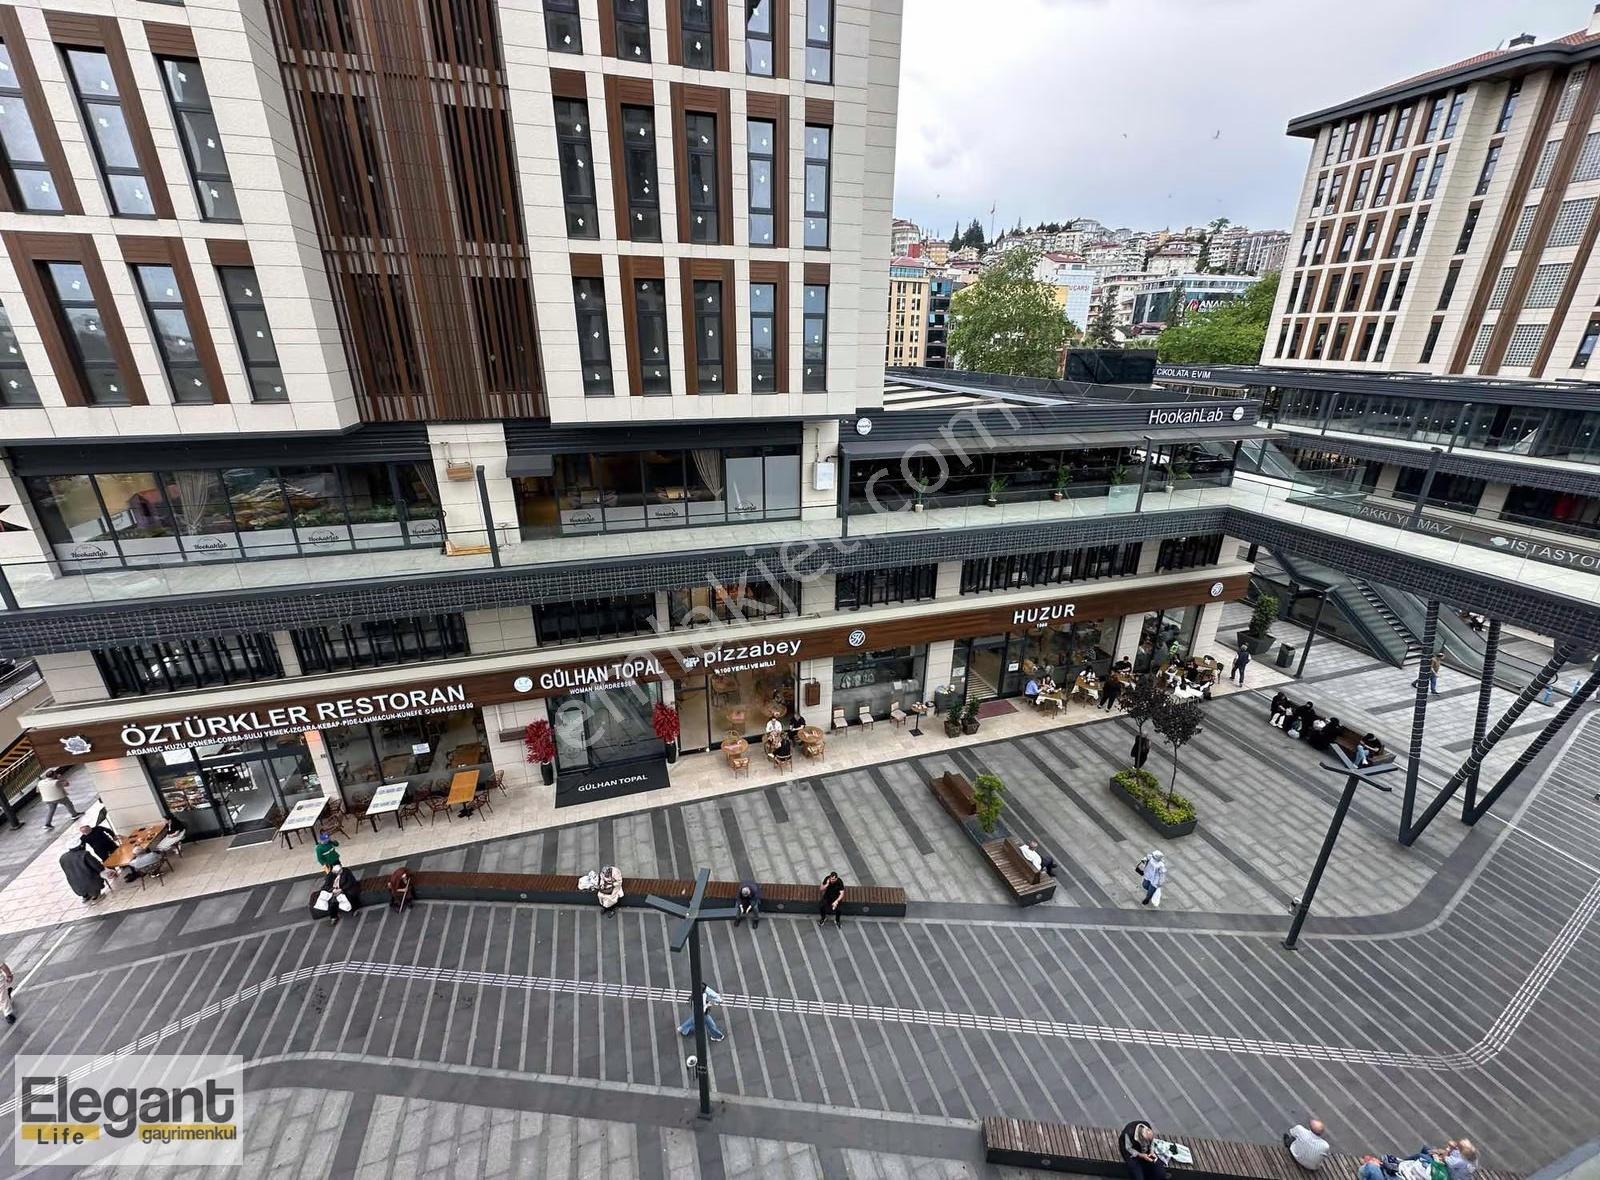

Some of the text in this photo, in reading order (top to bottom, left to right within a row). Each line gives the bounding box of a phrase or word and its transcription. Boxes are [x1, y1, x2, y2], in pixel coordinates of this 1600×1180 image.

[1148, 407, 1223, 425] HookahLab
[1397, 513, 1453, 535] YIMAZ
[1013, 604, 1075, 624] HUZUR
[704, 640, 801, 667] pizzabey
[540, 665, 609, 690] GÜLHAN
[612, 659, 665, 680] TOPAL
[570, 686, 593, 695] WOMAN
[121, 684, 466, 747] ÖZTÜRKLER RESTORAN
[165, 741, 186, 752] KUZU
[619, 774, 648, 785] TOPAL
